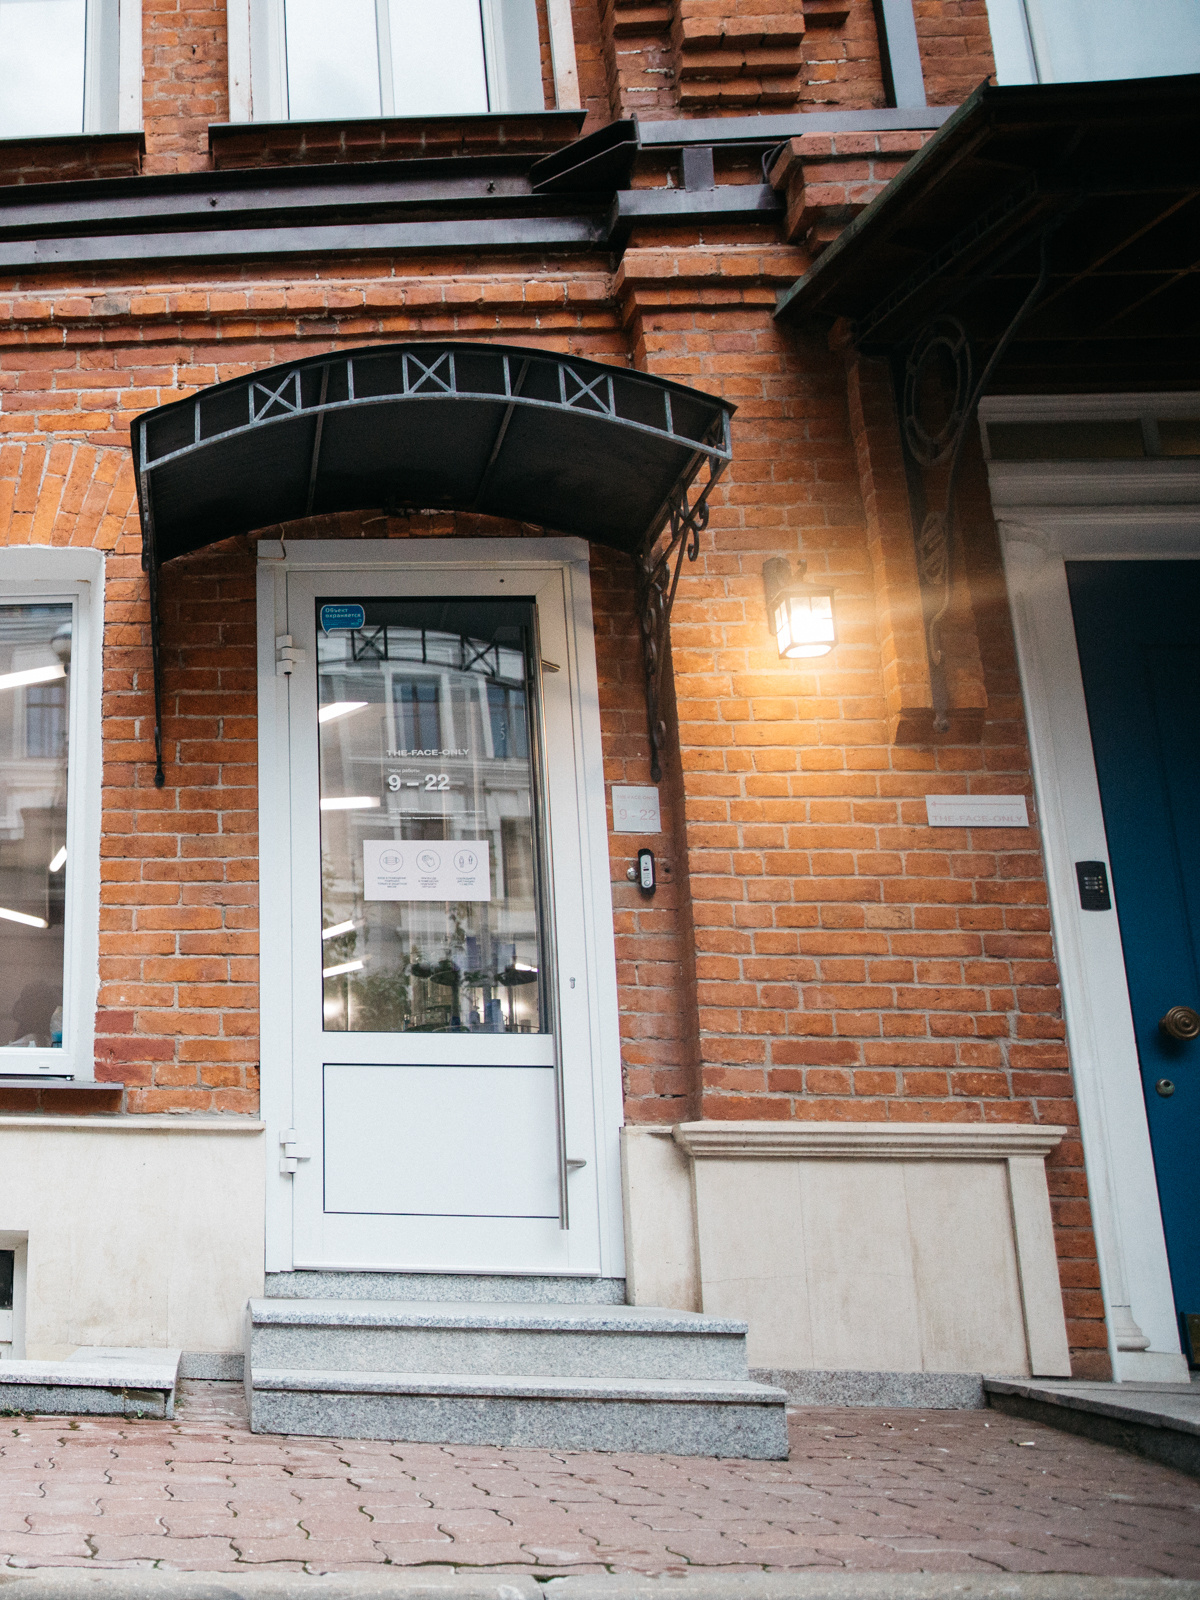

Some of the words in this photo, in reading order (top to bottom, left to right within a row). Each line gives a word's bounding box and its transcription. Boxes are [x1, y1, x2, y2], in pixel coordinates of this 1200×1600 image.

[386, 748, 469, 757] THE-FACE-ONLY
[388, 774, 401, 791] 9
[424, 773, 450, 790] 22
[619, 808, 628, 820] 9
[639, 808, 656, 820] 22
